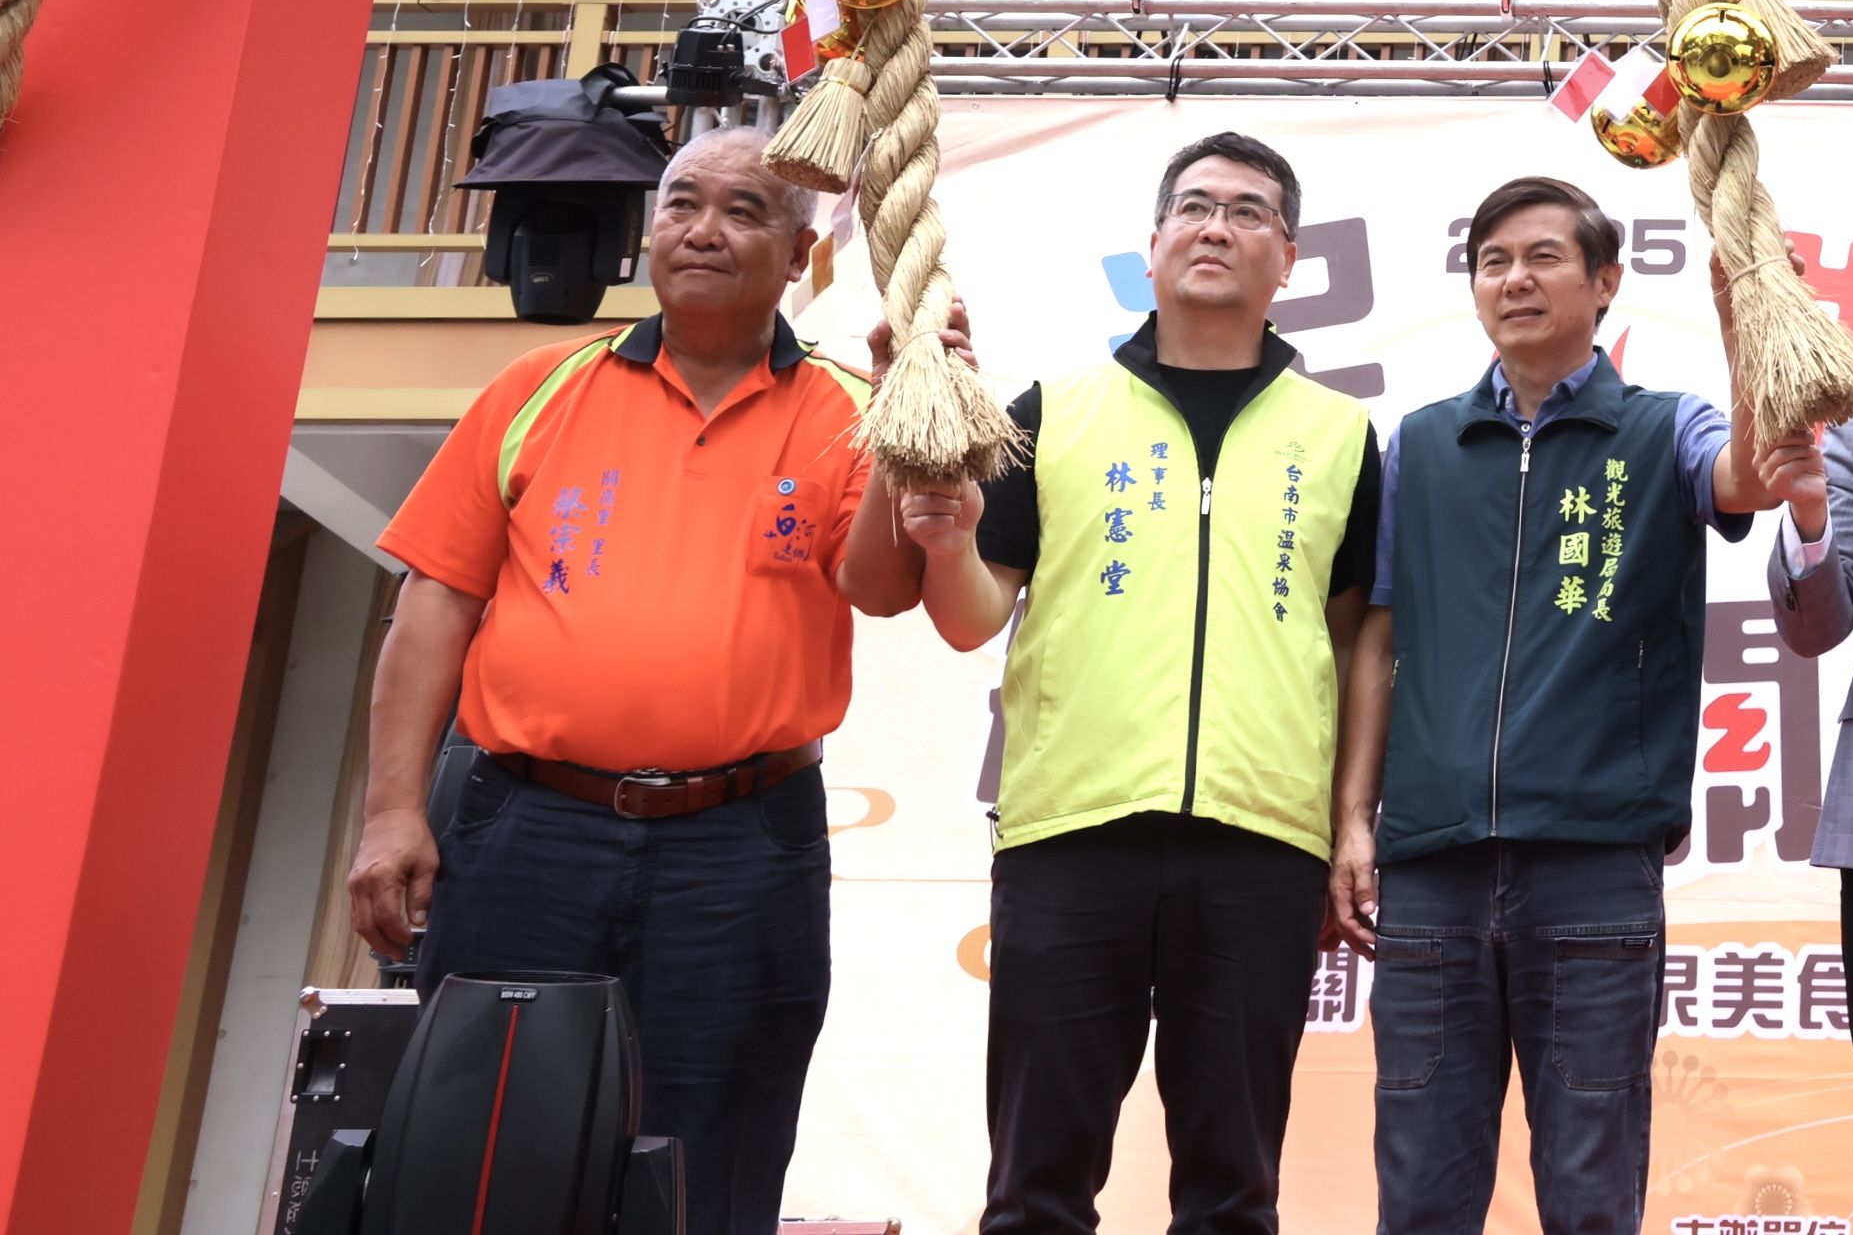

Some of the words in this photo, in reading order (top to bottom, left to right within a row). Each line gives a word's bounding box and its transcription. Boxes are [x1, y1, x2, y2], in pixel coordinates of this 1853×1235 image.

[1101, 462, 1137, 596] 林憲堂
[1148, 442, 1168, 511] 理事長
[1554, 486, 1597, 615] 林國華
